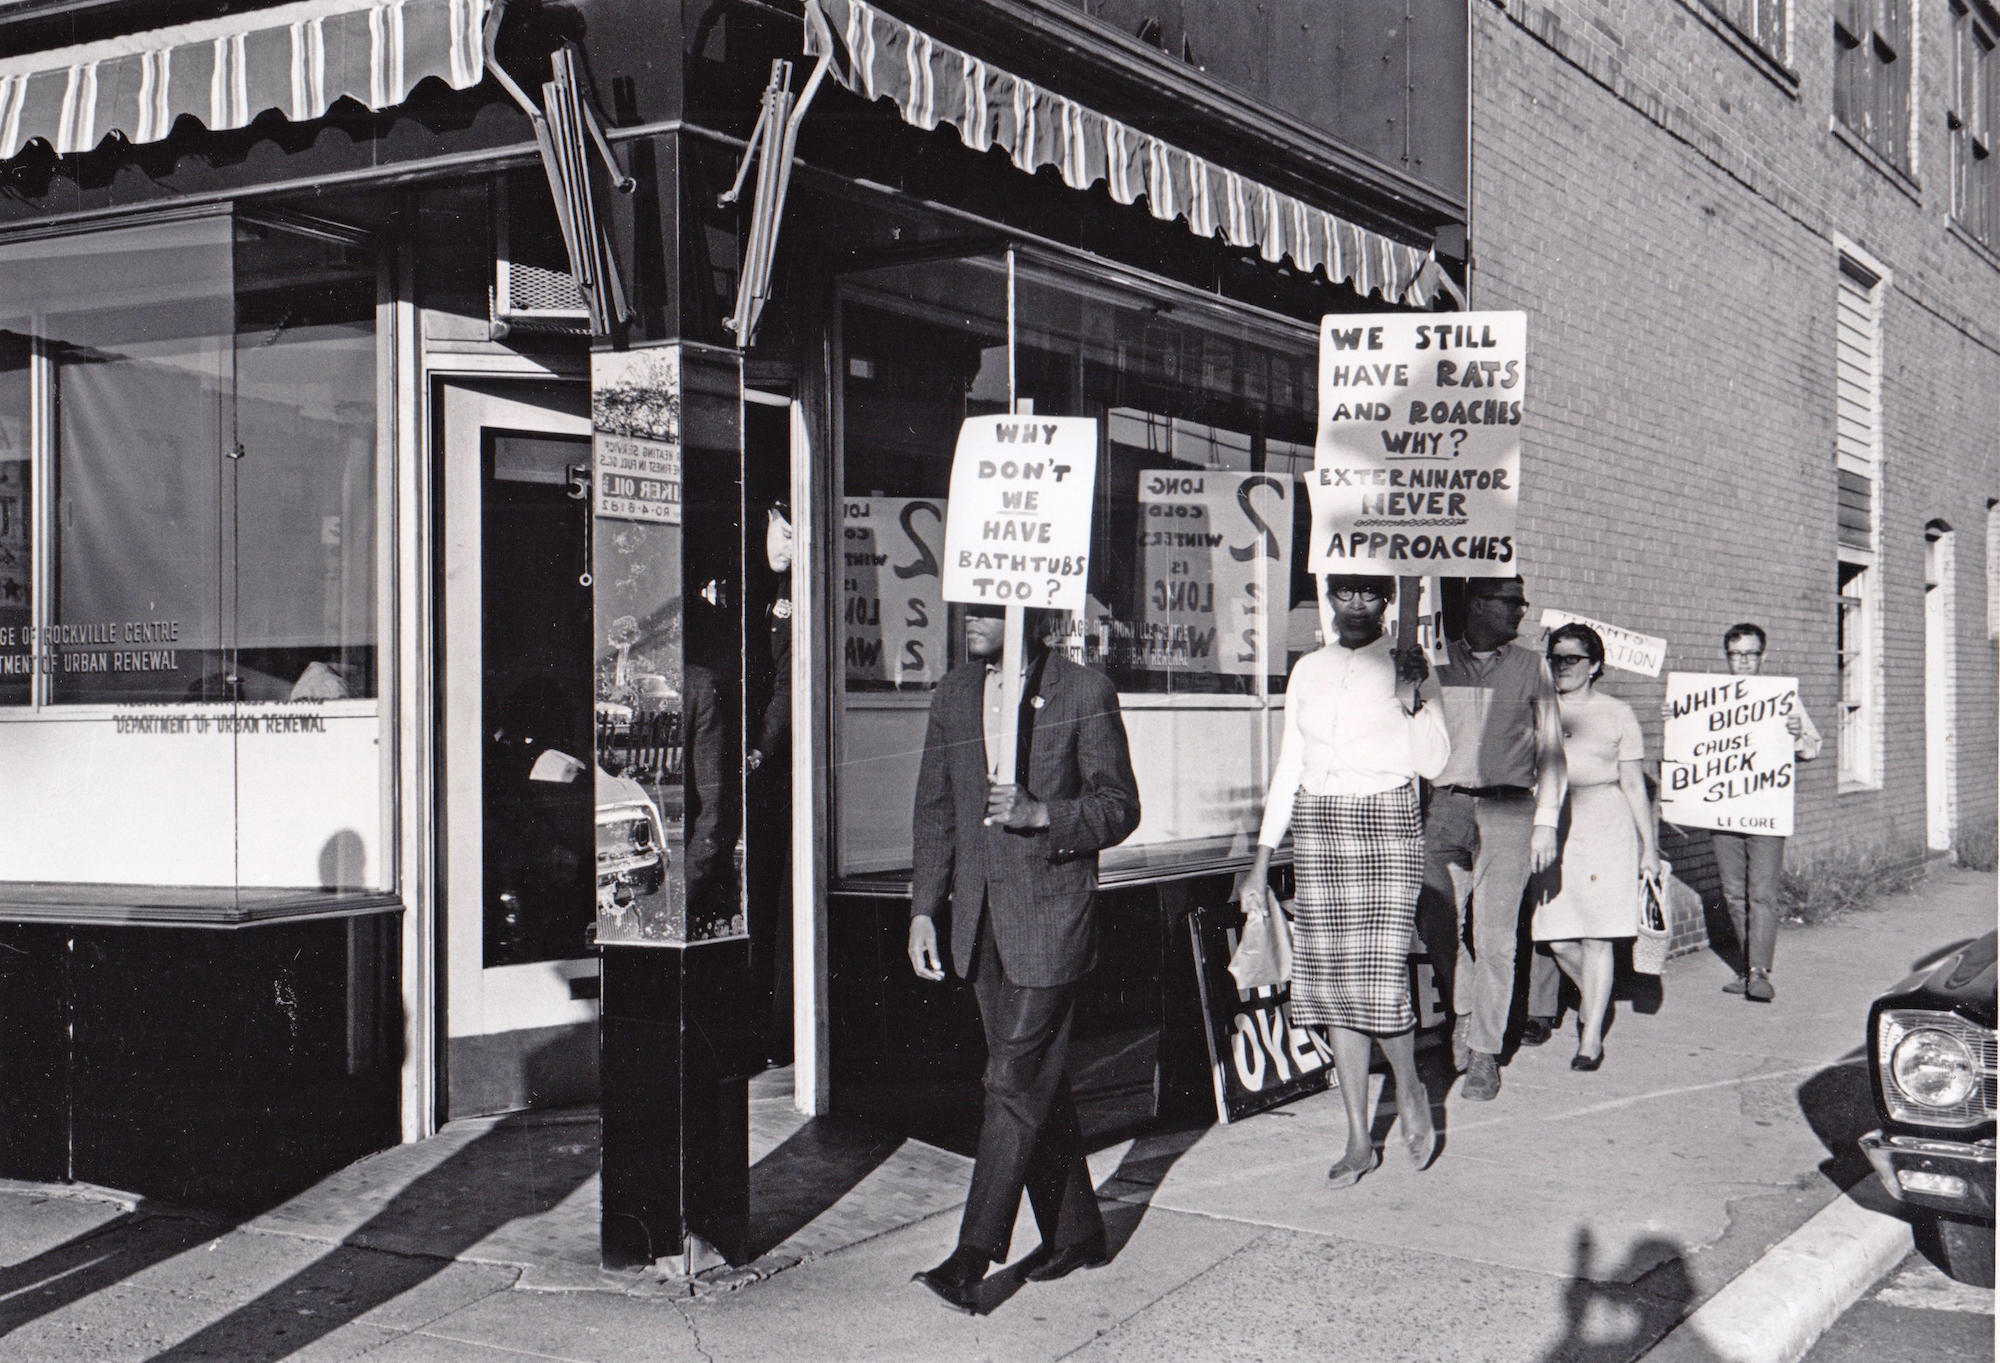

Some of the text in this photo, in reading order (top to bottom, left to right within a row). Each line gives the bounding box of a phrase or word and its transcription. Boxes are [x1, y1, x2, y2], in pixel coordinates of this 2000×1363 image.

[1331, 325, 1496, 350] WE STILL
[1333, 359, 1519, 389] HAVE RATS
[1332, 399, 1522, 426] AND ROACHES
[996, 423, 1058, 445] WHY
[1381, 428, 1468, 457] WHY?
[978, 458, 1071, 482] DON'T
[1320, 468, 1511, 490] EXTERMINATOR
[1002, 491, 1039, 510] WE
[1362, 492, 1468, 517] NEVER
[983, 520, 1052, 543] HAVE
[1326, 532, 1513, 563] APPROACHES
[958, 550, 1086, 576] BATHTUBS
[43, 622, 117, 646] ROCKVILLE
[124, 620, 179, 643] CENTRE
[64, 652, 108, 673] URBAN
[113, 650, 179, 672] RENEWAL
[1673, 679, 1749, 719] WHITE
[1709, 690, 1796, 731] BIGOTS
[113, 712, 326, 734] DEPARTMENT OF URBAN RENEWAL
[1693, 732, 1754, 757] CAUSE
[1672, 751, 1757, 791] BLACK
[1703, 763, 1792, 803] SLUMS
[1717, 816, 1777, 829] LI CORE
